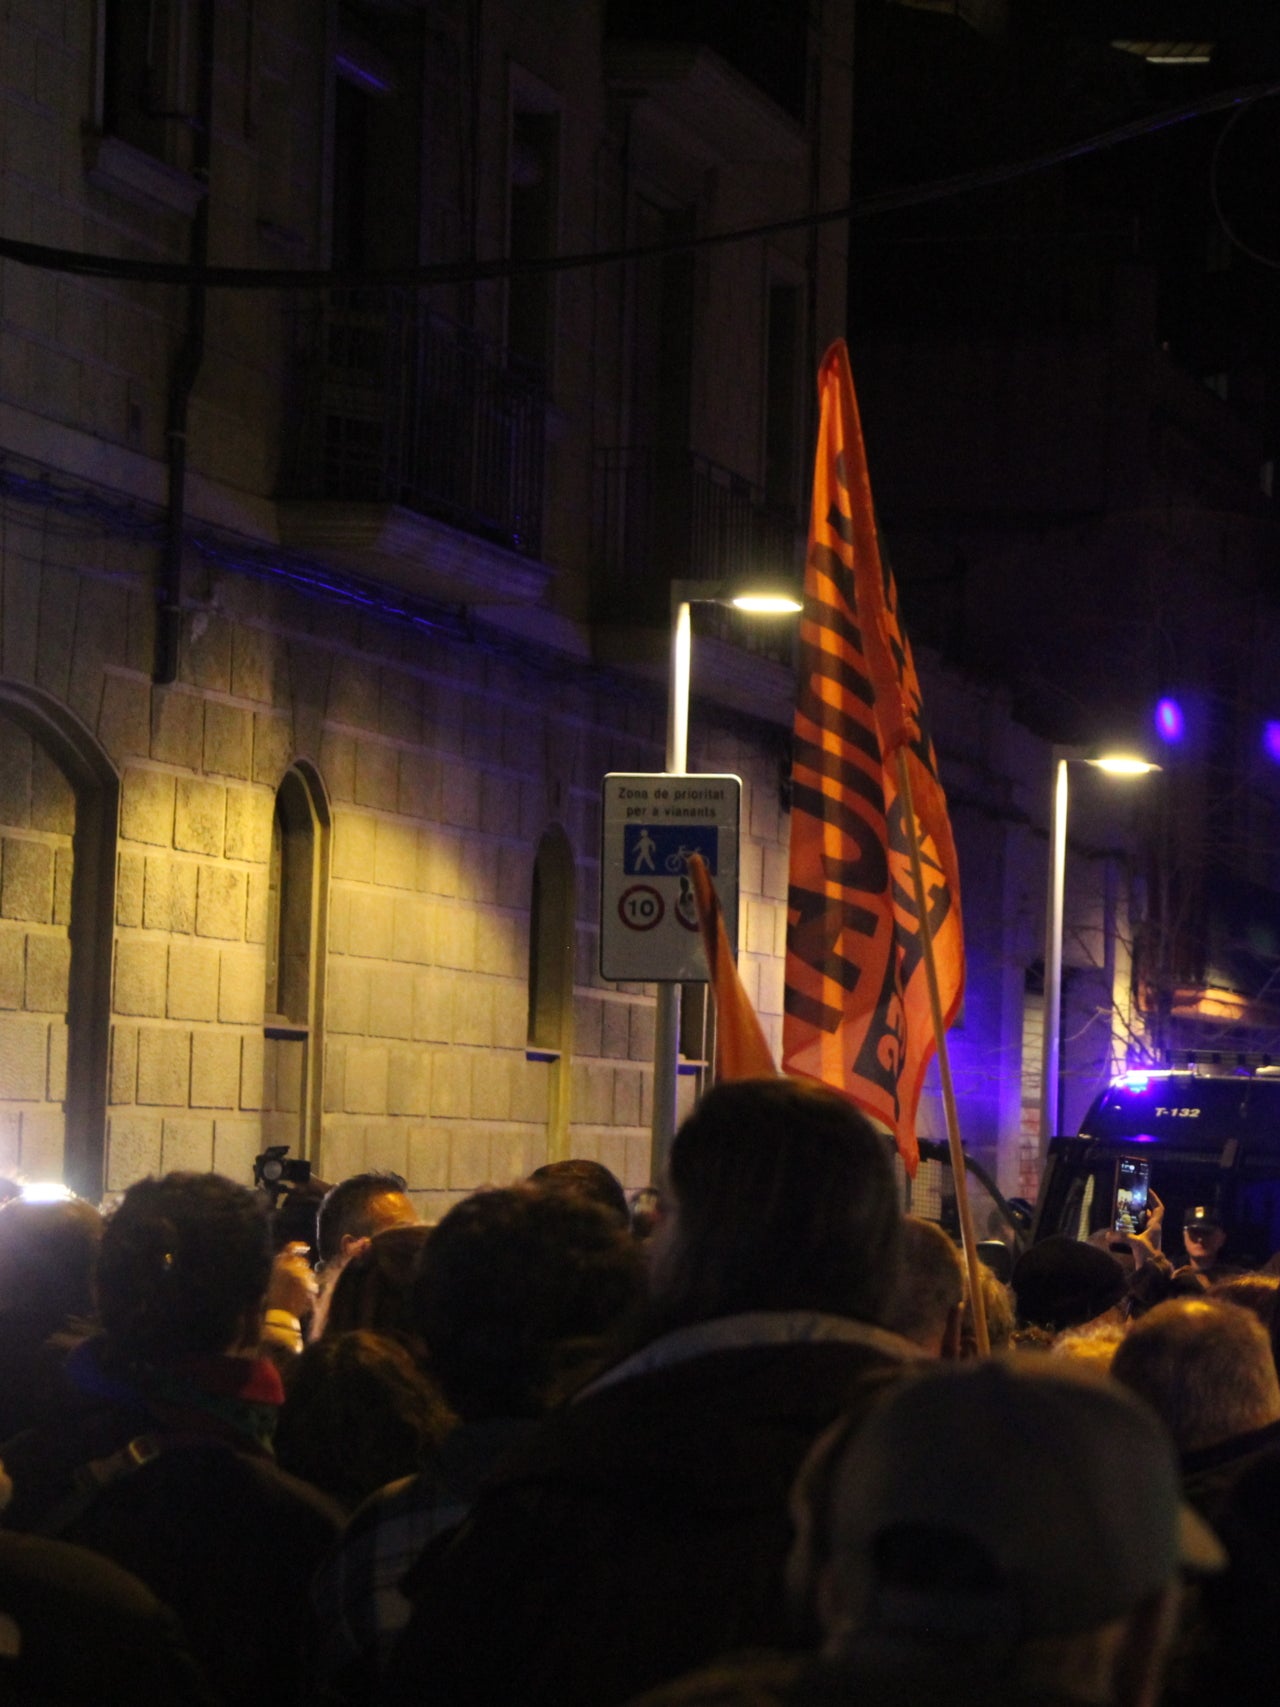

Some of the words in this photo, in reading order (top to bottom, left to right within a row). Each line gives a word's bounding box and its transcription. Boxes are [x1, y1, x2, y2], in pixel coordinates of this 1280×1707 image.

[618, 787, 649, 800] Zona
[654, 788, 669, 800] de
[674, 788, 725, 802] prioritat
[627, 807, 647, 818] per
[652, 808, 659, 817] a
[664, 806, 717, 817] vianants
[629, 900, 655, 917] 10
[1155, 1107, 1200, 1118] T-132
